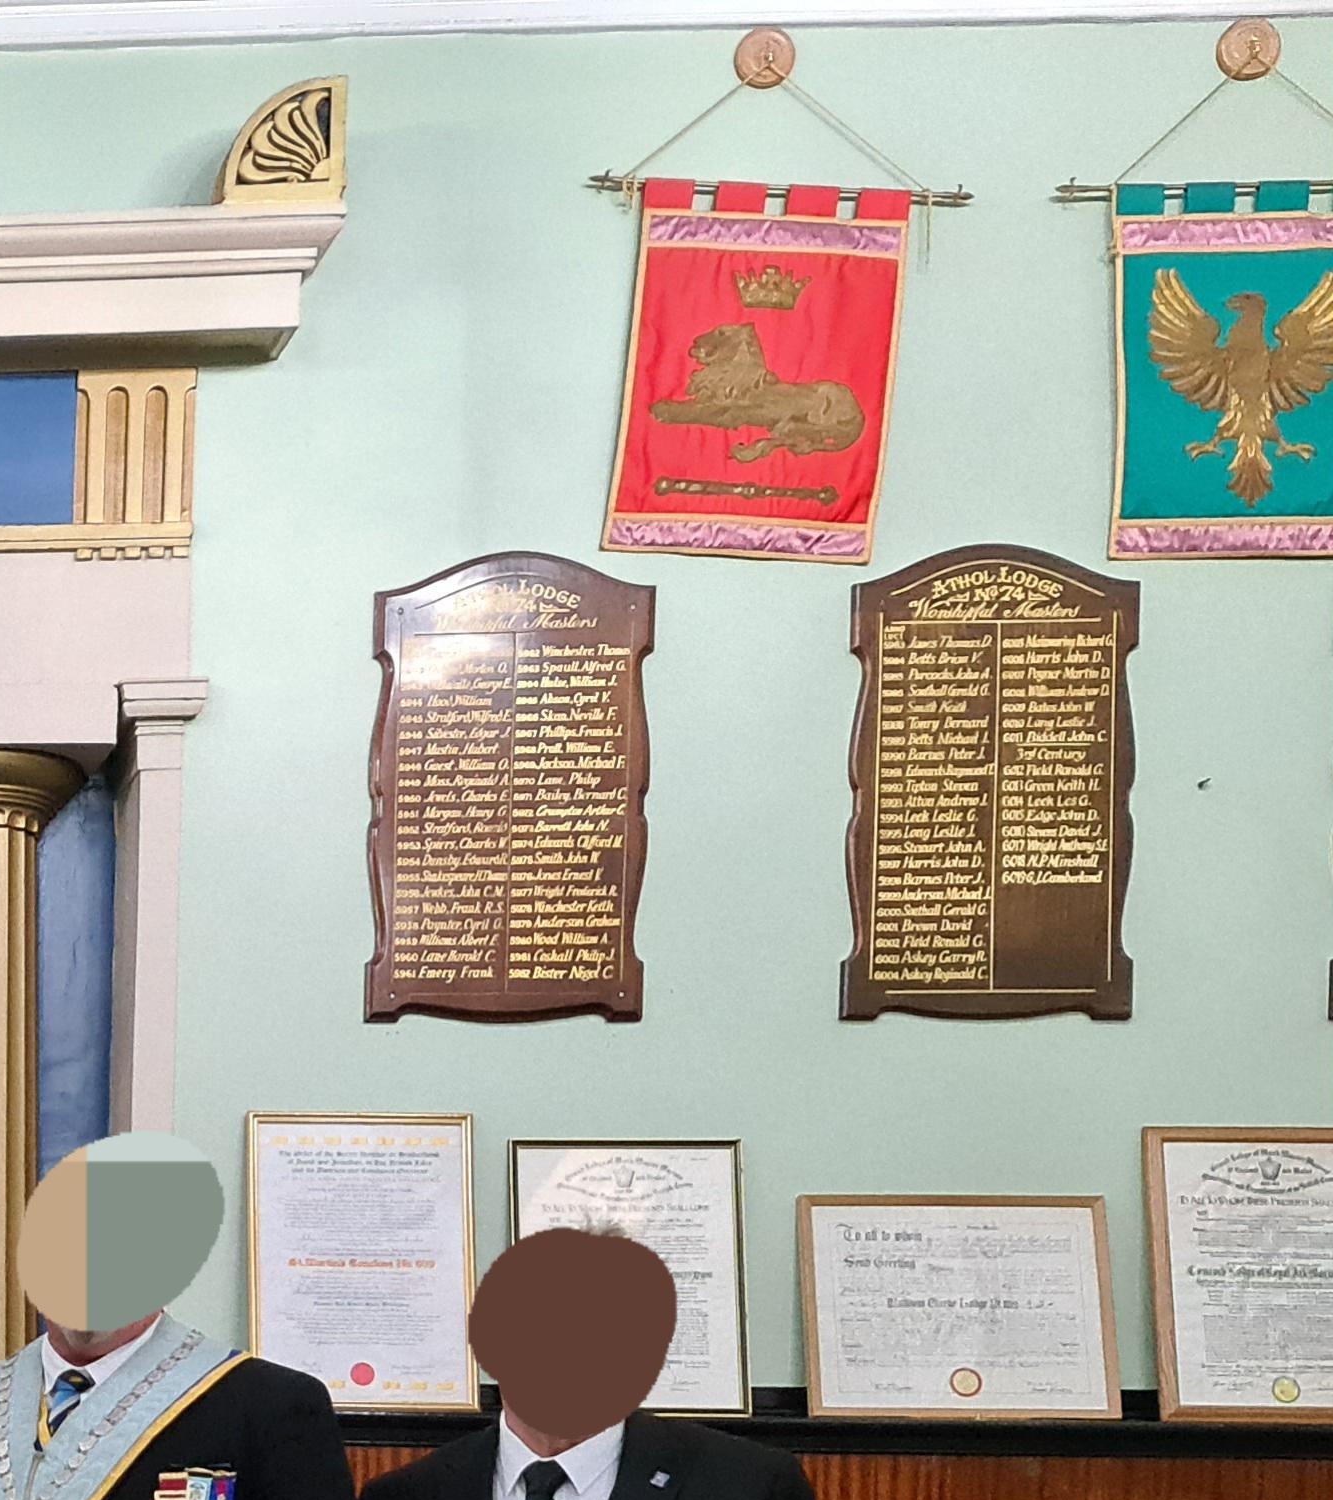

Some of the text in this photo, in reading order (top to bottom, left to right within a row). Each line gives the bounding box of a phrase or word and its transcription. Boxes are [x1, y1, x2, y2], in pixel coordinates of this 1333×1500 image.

[517, 579, 581, 609] LODGE
[931, 566, 1064, 599] ATHOL LODGE
[998, 586, 1025, 601] 74
[909, 597, 1081, 621] Worshipful Masters
[1037, 749, 1087, 761] Century
